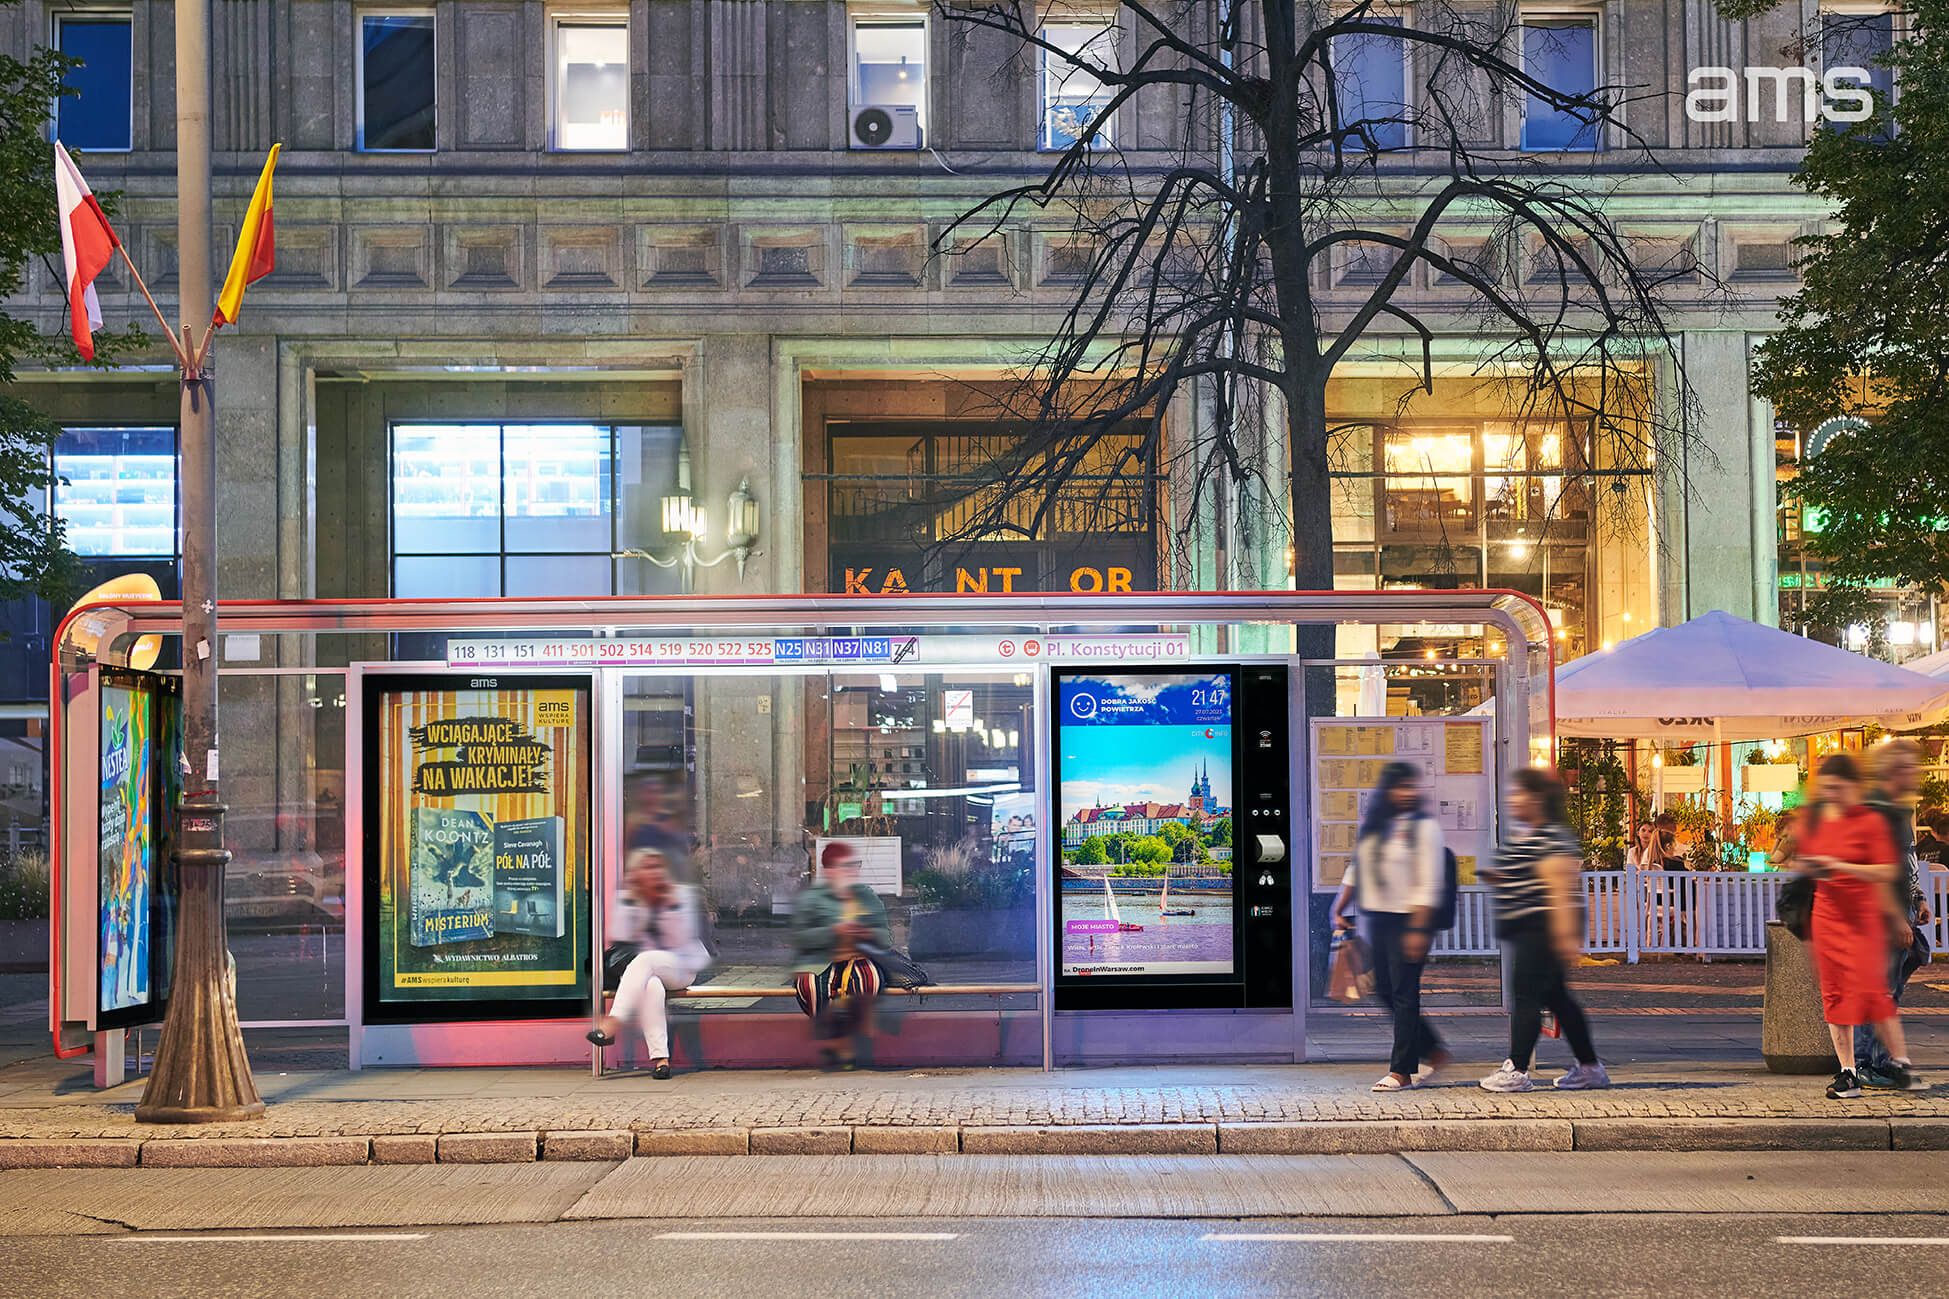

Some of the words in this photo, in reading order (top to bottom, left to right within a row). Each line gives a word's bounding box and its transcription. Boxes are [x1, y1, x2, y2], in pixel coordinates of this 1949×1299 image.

[454, 645, 475, 658] 118
[484, 645, 505, 658] 131
[514, 644, 535, 657] 151
[543, 644, 563, 657] 411
[571, 643, 594, 657] 501
[600, 643, 624, 657] 502
[630, 643, 653, 656] 514
[660, 643, 682, 656] 519
[689, 642, 713, 655] 520
[718, 642, 742, 655] 522
[748, 642, 772, 655] 525
[776, 642, 801, 655] N25
[806, 641, 830, 655] N31
[834, 641, 859, 654] N37
[863, 641, 889, 654] N81
[1047, 642, 1065, 656] Pl.
[1072, 642, 1161, 660] Konstytucji
[1166, 642, 1184, 656] 01
[470, 678, 498, 688] ams
[538, 702, 569, 711] ams
[427, 724, 514, 746] WCIĄGAJĄCE
[468, 746, 542, 764] KRYMINAŁY
[423, 767, 446, 790] NA
[450, 765, 532, 790] WAKACJE!
[441, 817, 474, 829] DEAN
[424, 829, 489, 844] KOONTZ
[496, 852, 514, 870] PÓŁ
[516, 854, 530, 869] NA
[532, 850, 552, 869] PÓŁ
[425, 912, 489, 932] MISTERIUM
[445, 954, 500, 962] WYDAWNICTWO
